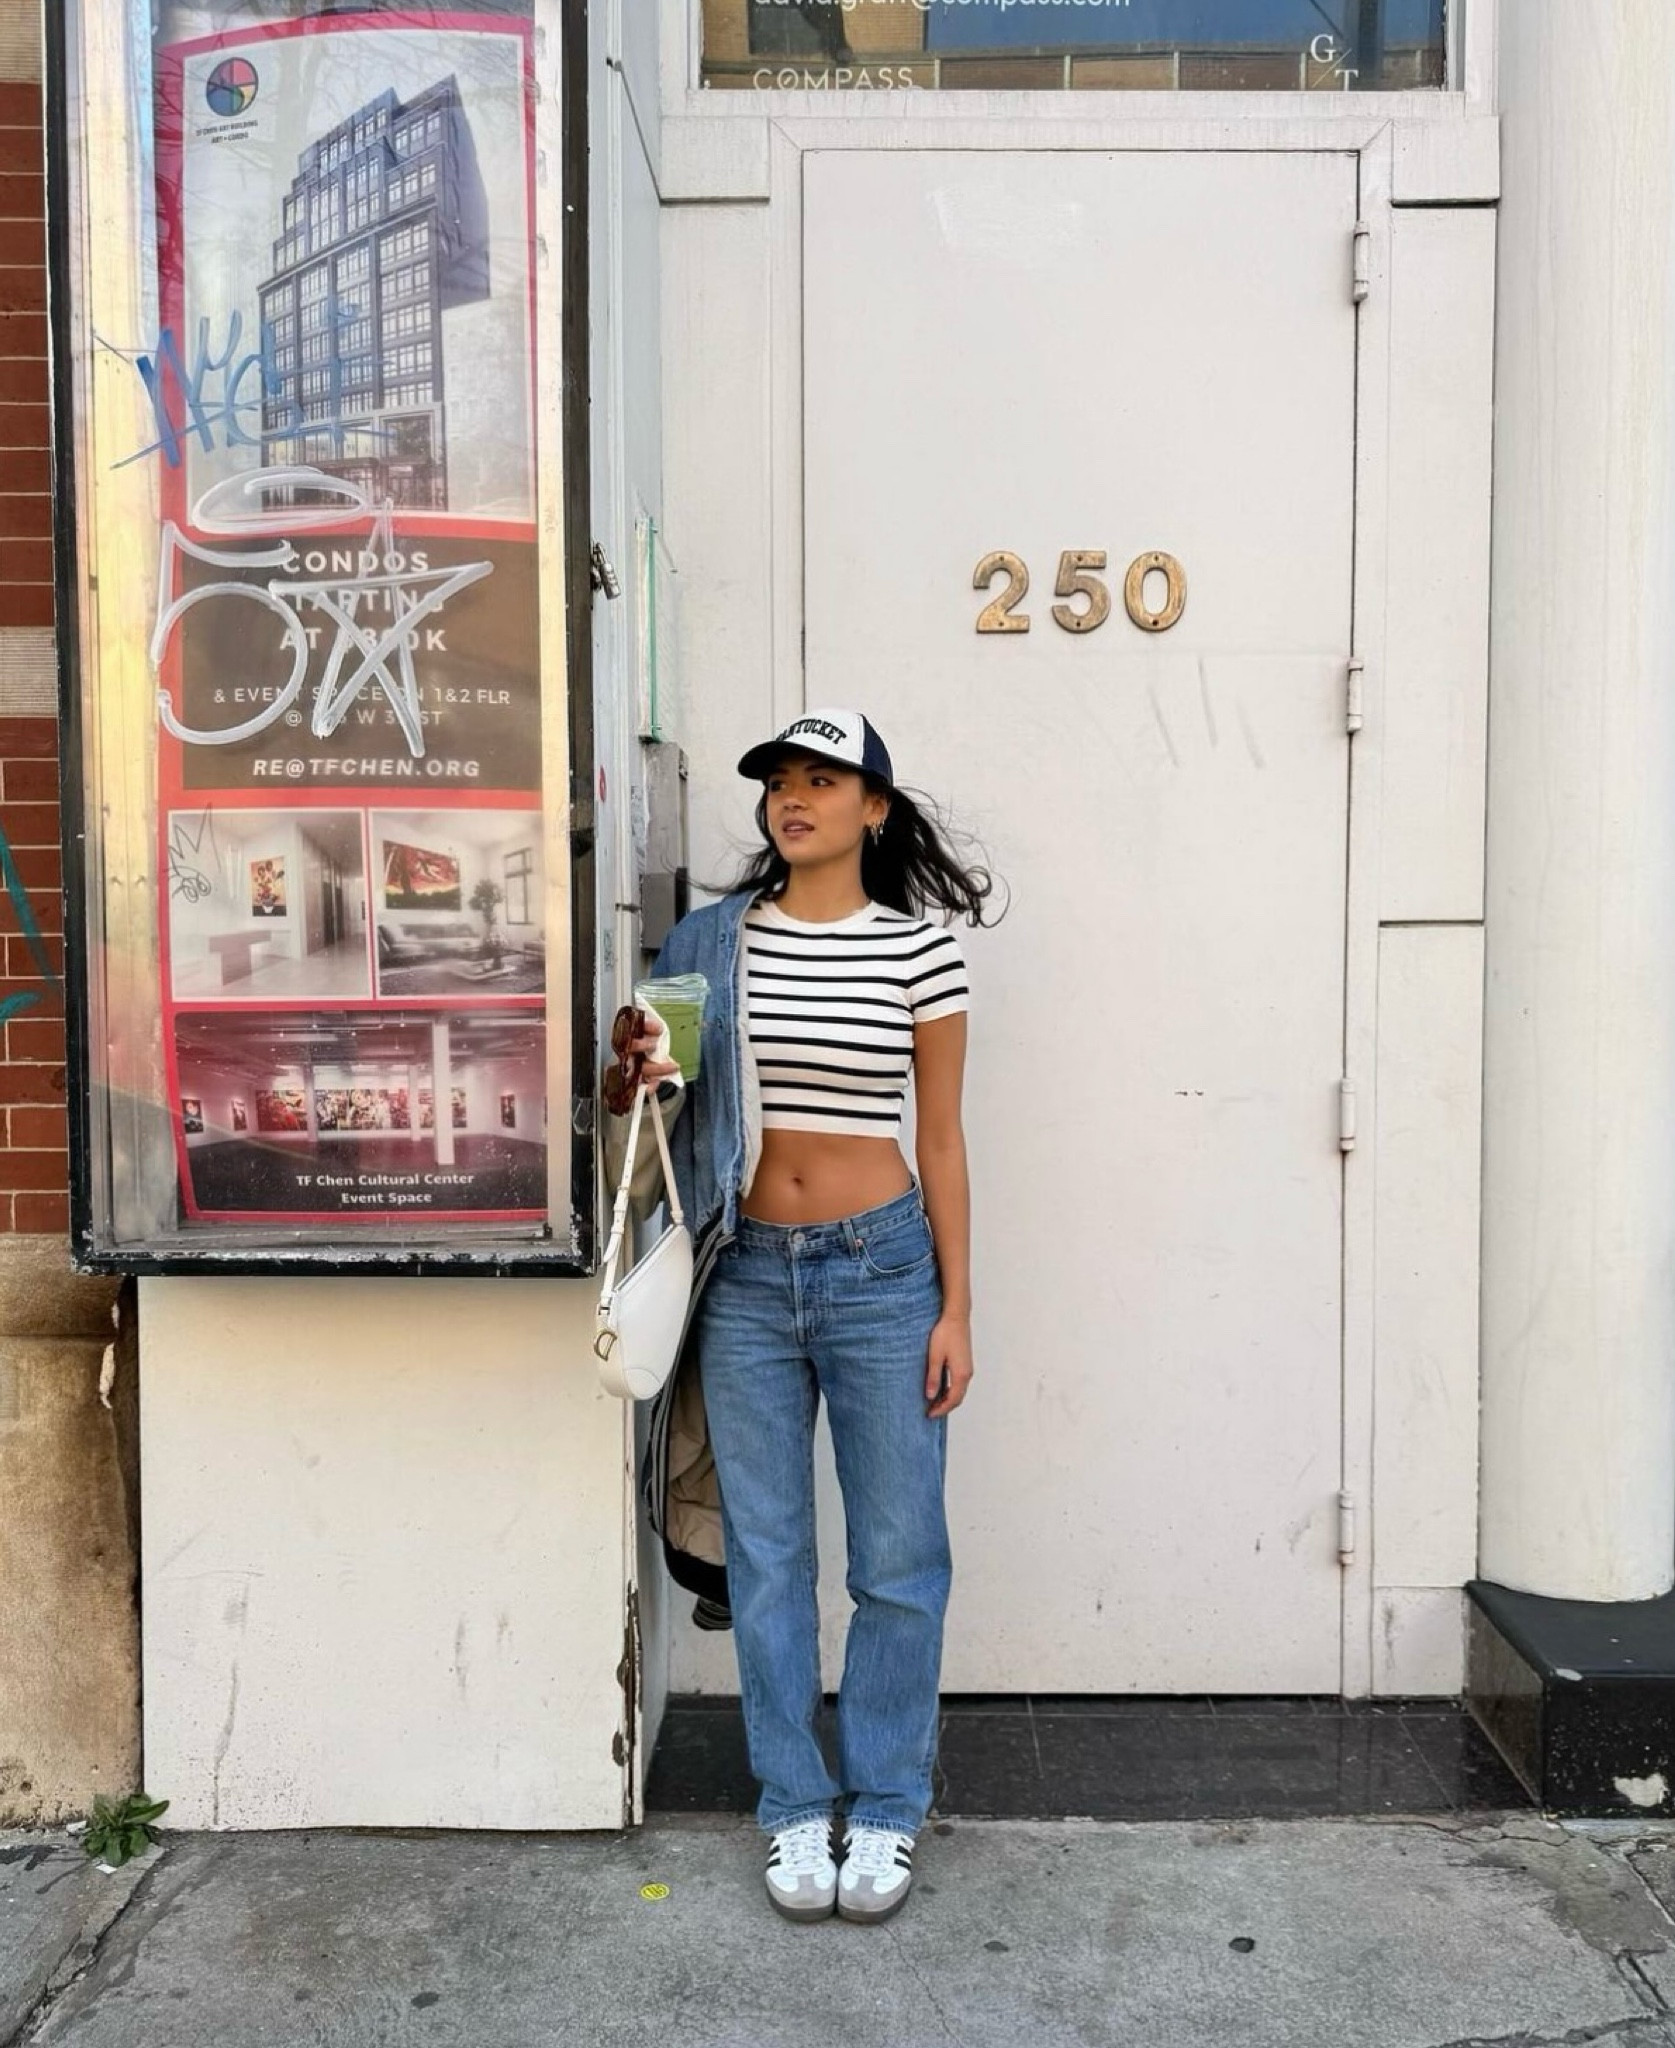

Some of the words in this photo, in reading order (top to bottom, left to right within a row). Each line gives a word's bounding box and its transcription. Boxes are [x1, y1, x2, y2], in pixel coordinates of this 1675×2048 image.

[752, 67, 914, 91] COMPASS
[282, 550, 429, 574] CONDOS
[973, 550, 1187, 634] 250
[214, 688, 226, 704] &
[434, 687, 471, 703] 1&2
[477, 688, 511, 705] FLR
[285, 709, 303, 728] @
[356, 709, 376, 726] W
[253, 758, 481, 779] RE@TFCHEN.ORG
[296, 1174, 312, 1187] TF
[316, 1174, 354, 1187] Chen
[358, 1173, 420, 1186] Cultural
[424, 1173, 475, 1185] Center
[341, 1192, 384, 1204] Event
[388, 1192, 432, 1206] Space
